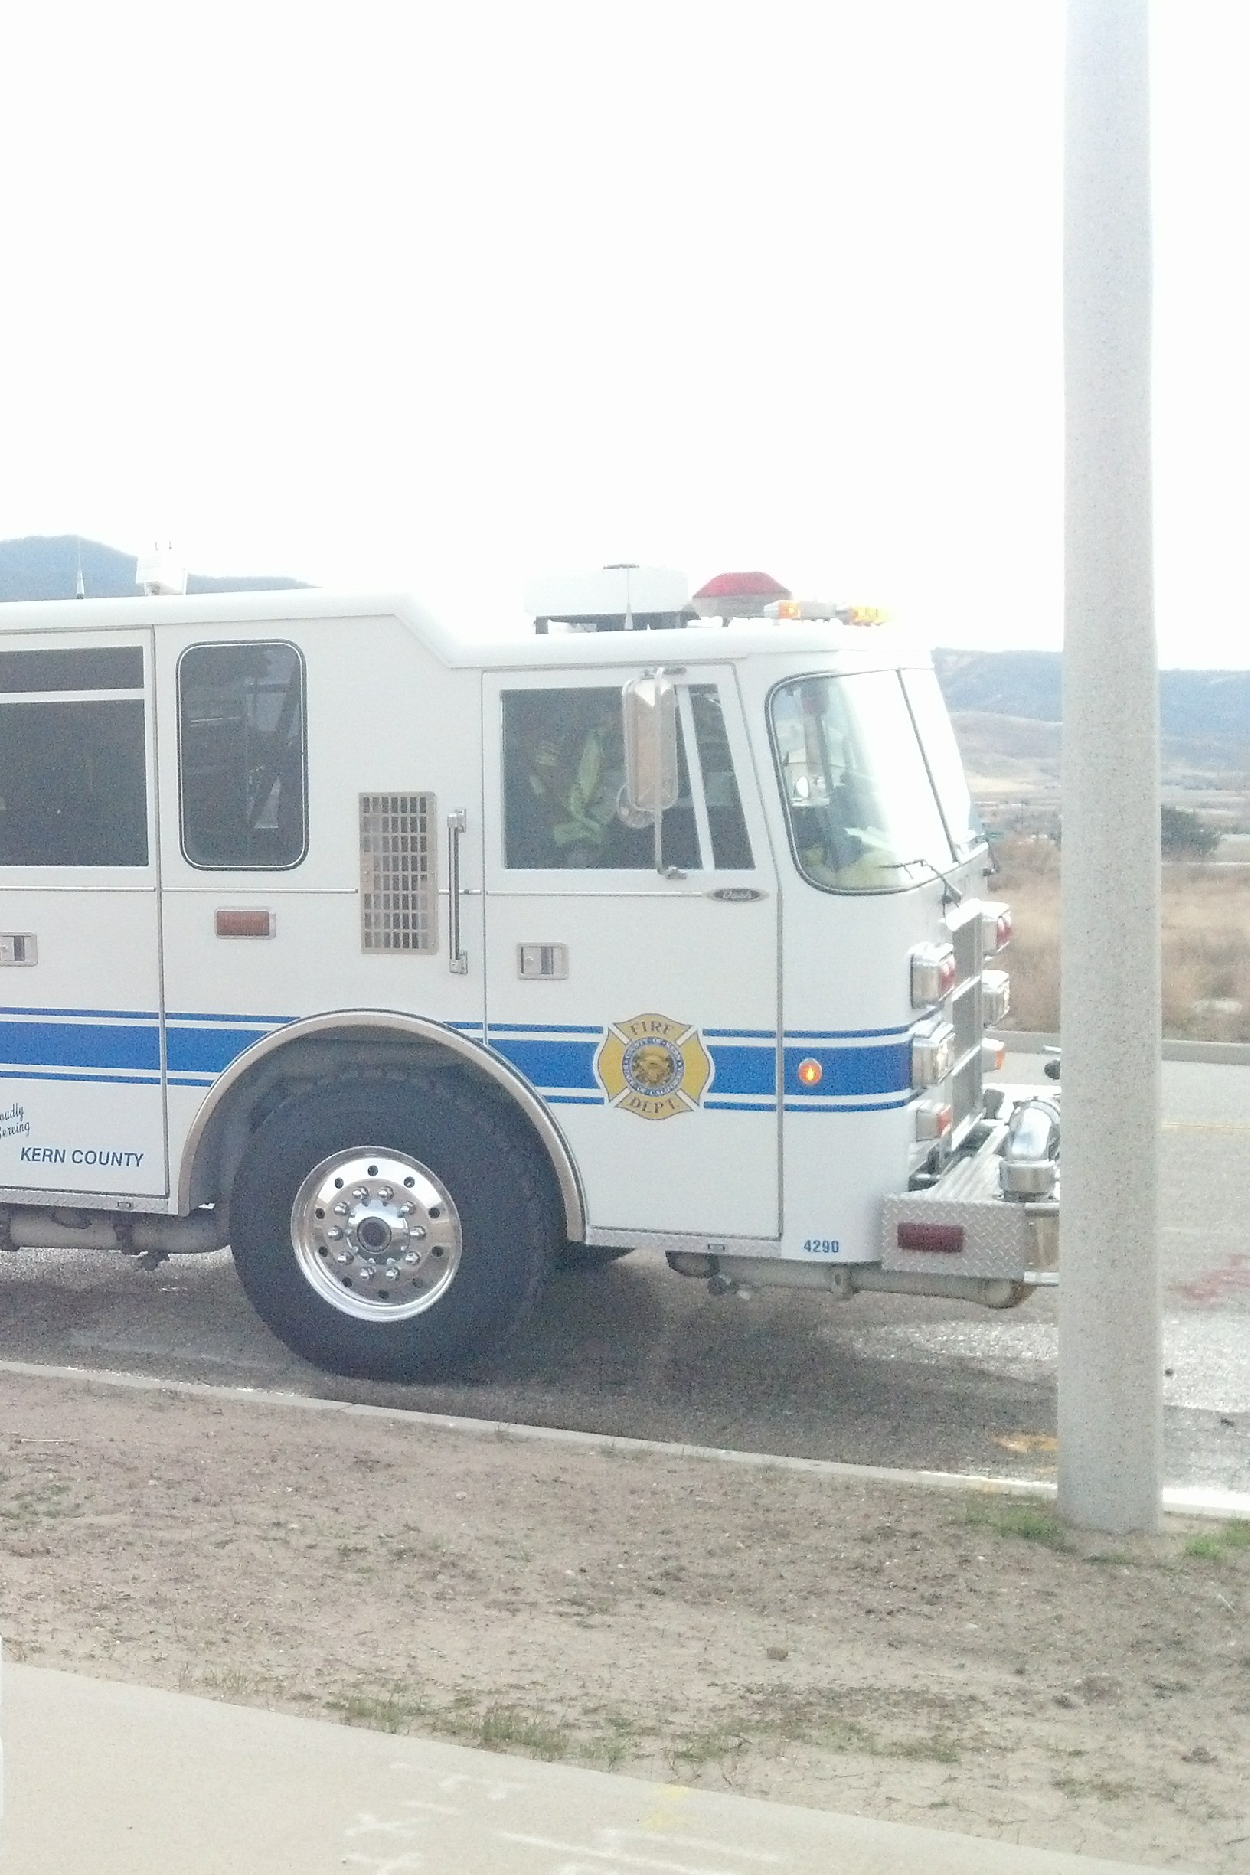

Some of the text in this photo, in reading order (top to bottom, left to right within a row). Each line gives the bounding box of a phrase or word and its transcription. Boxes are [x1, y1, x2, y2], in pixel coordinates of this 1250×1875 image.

[629, 1021, 674, 1035] FIRE
[629, 1097, 677, 1113] DEPT
[20, 1146, 144, 1167] KERN COUNTY
[803, 1239, 839, 1253] 4290
